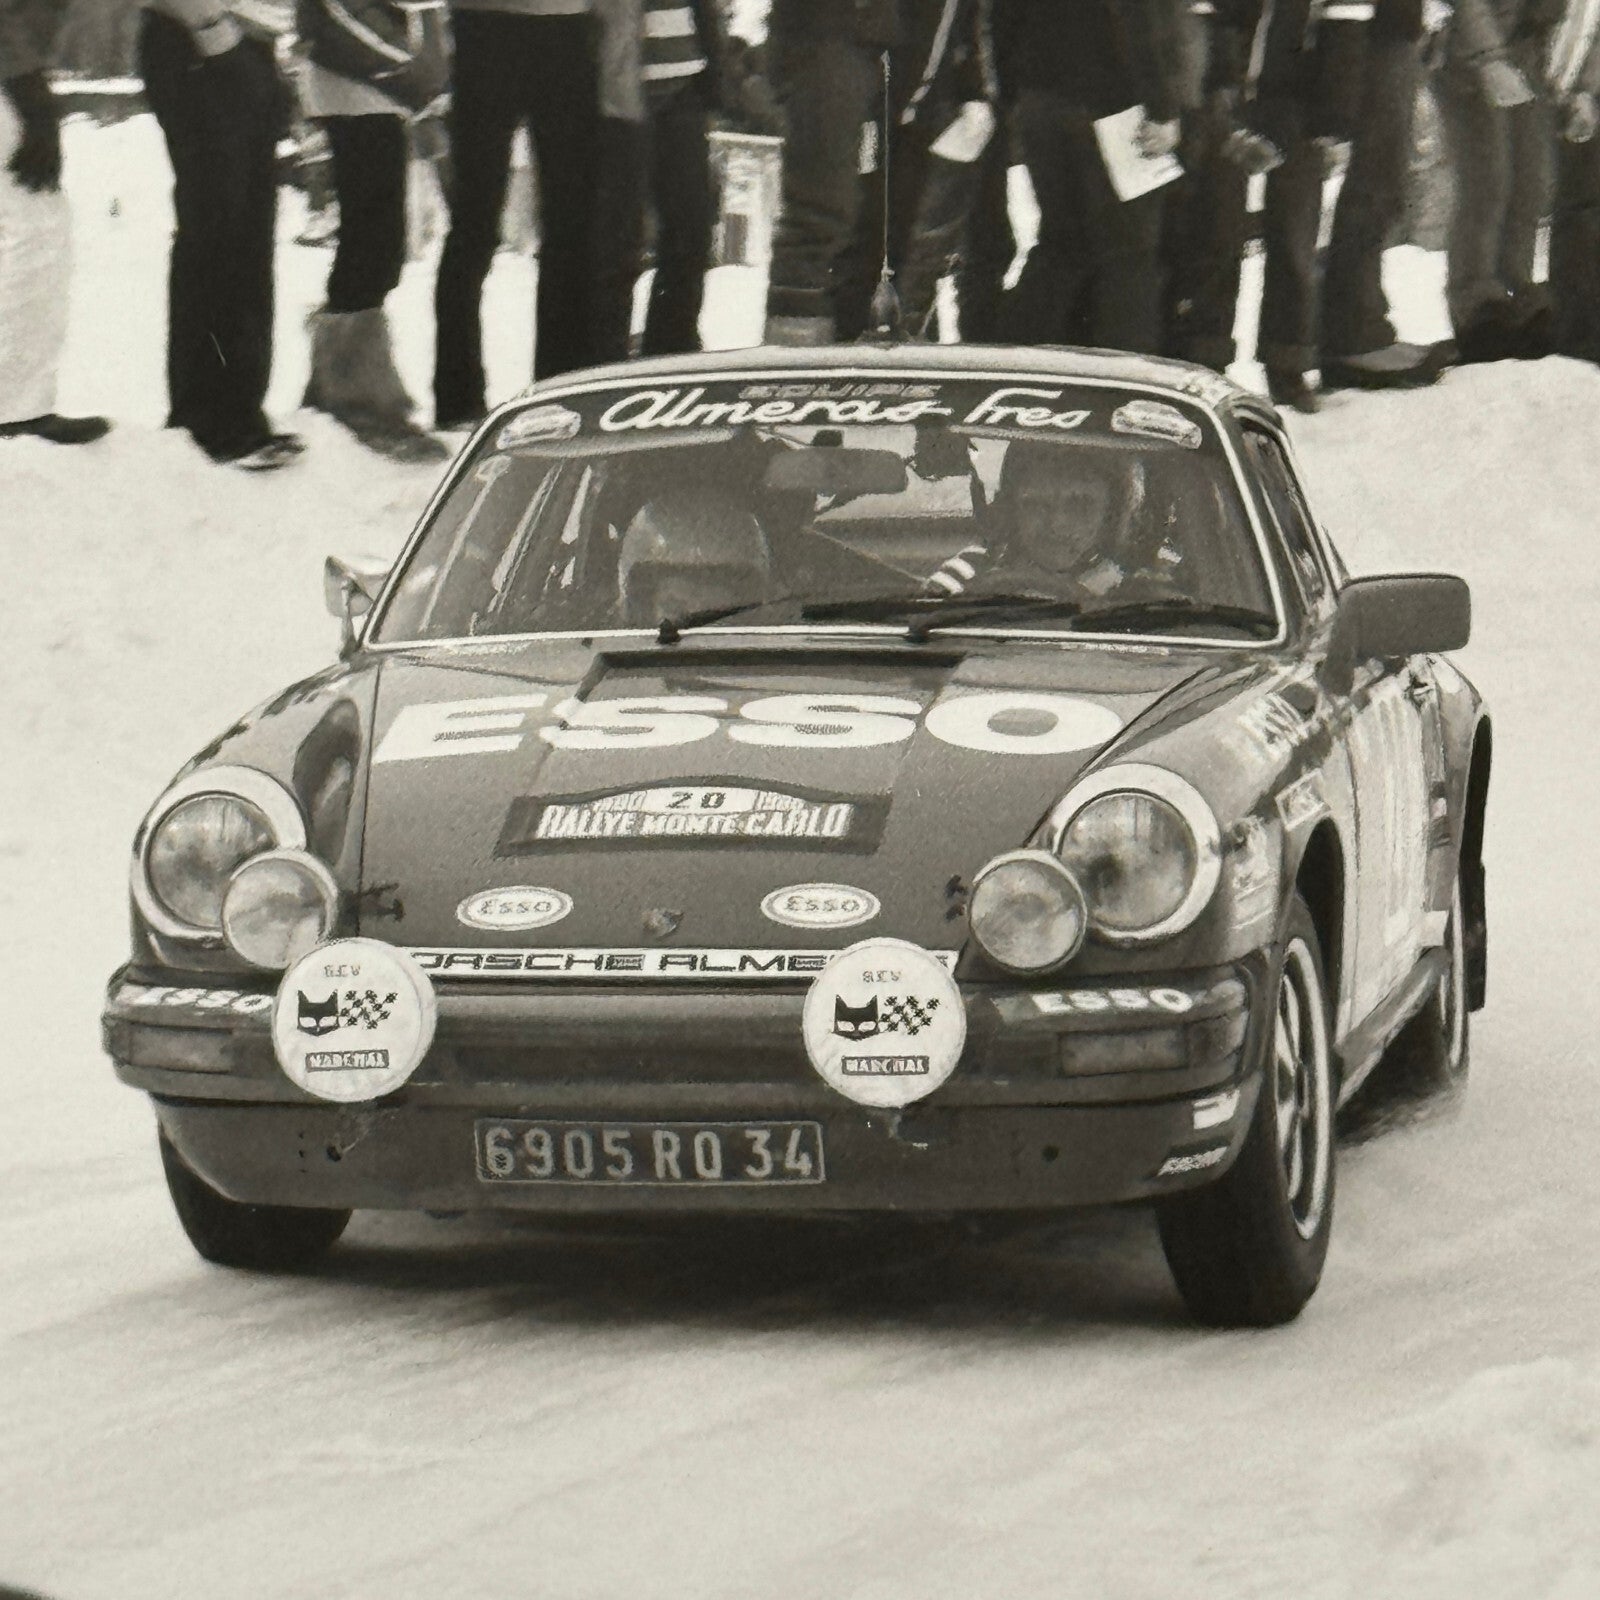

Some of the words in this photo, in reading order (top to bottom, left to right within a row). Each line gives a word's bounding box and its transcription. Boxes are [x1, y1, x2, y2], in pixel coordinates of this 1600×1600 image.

[371, 693, 1124, 764] ESSO
[665, 791, 727, 809] 20
[537, 804, 639, 838] RALLYE
[640, 812, 742, 836] MONTE
[744, 803, 854, 838] CARLO
[786, 896, 860, 912] ESSO
[659, 953, 836, 972] ALME
[485, 1126, 634, 1178] 6905
[744, 1128, 813, 1179] 34
